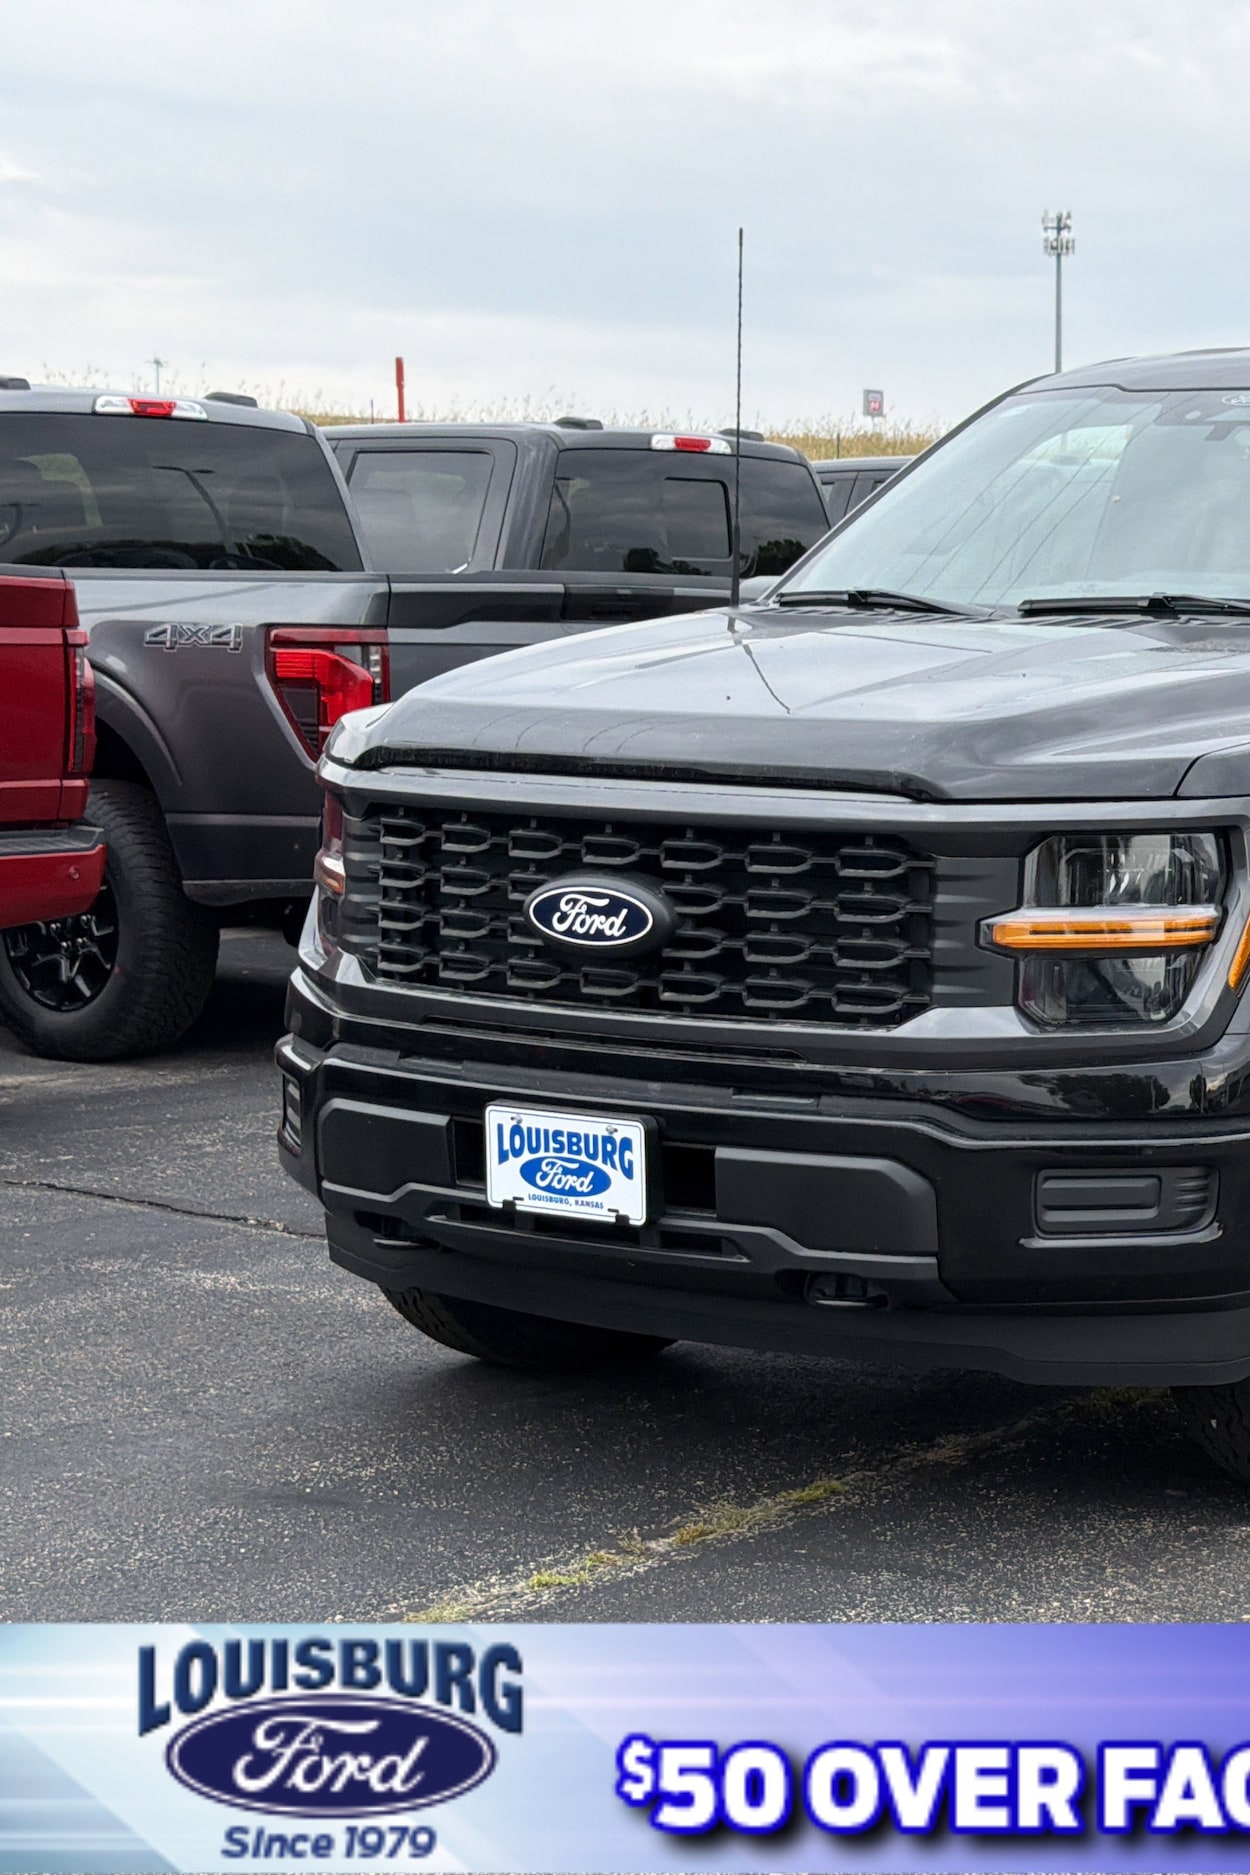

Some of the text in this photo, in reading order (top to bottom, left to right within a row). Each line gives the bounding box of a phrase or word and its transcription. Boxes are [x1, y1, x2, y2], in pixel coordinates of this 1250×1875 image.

[552, 893, 627, 937] Ford
[497, 1123, 634, 1181] LOUISBURG
[535, 1158, 595, 1193] Ford
[528, 1193, 604, 1210] LOUISBURG, KANSAS
